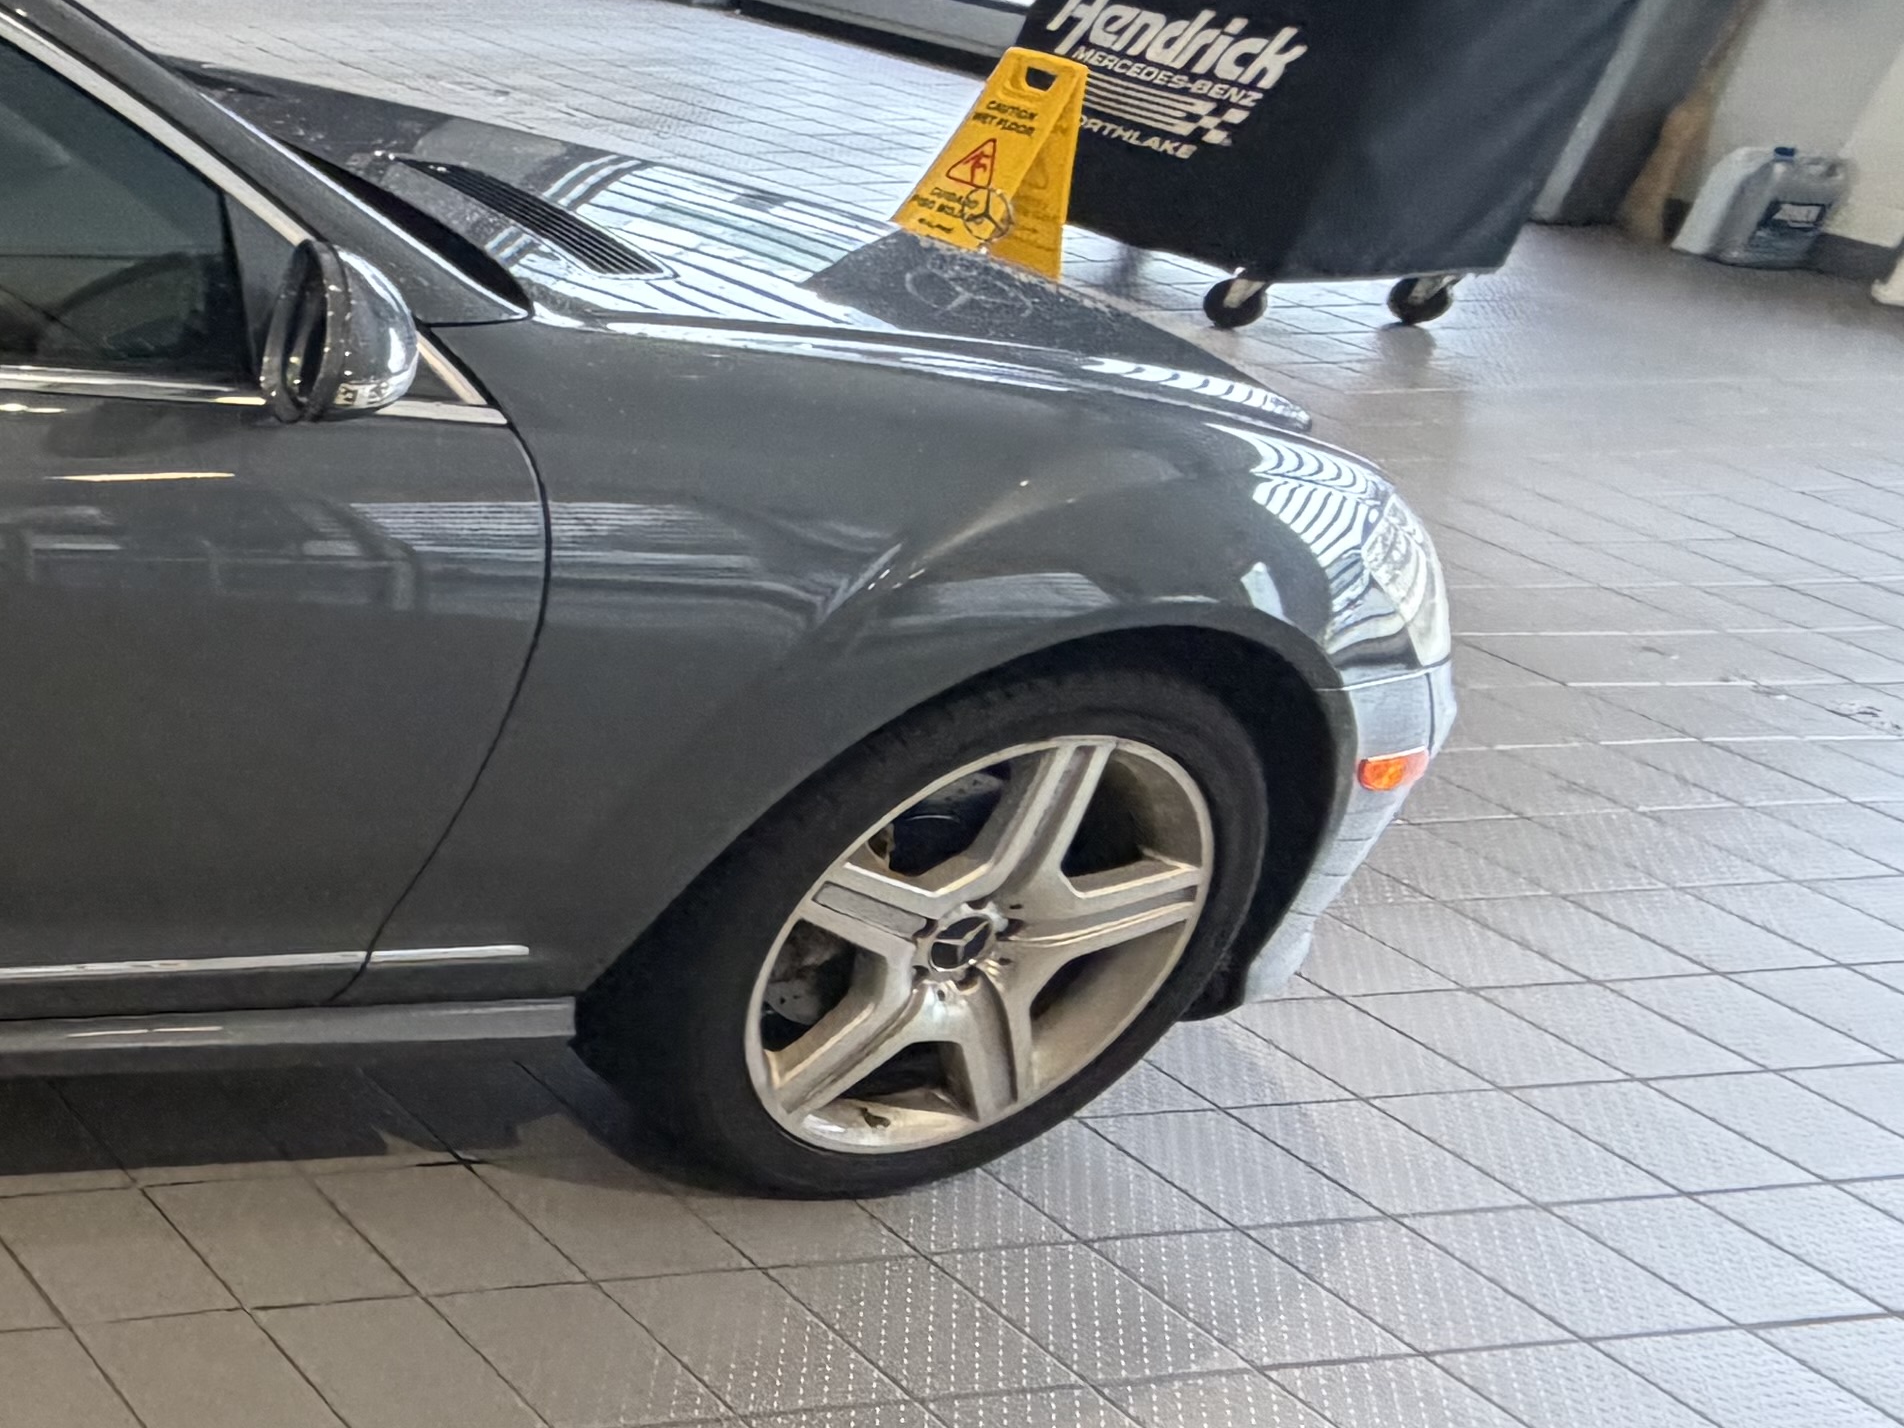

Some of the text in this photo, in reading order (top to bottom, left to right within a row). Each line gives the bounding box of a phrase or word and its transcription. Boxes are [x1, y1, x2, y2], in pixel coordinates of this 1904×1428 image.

[1072, 46, 1264, 107] MERCEDES-BENZ
[986, 101, 1039, 121] CAUTION
[1080, 115, 1198, 160] ORTHLAKE
